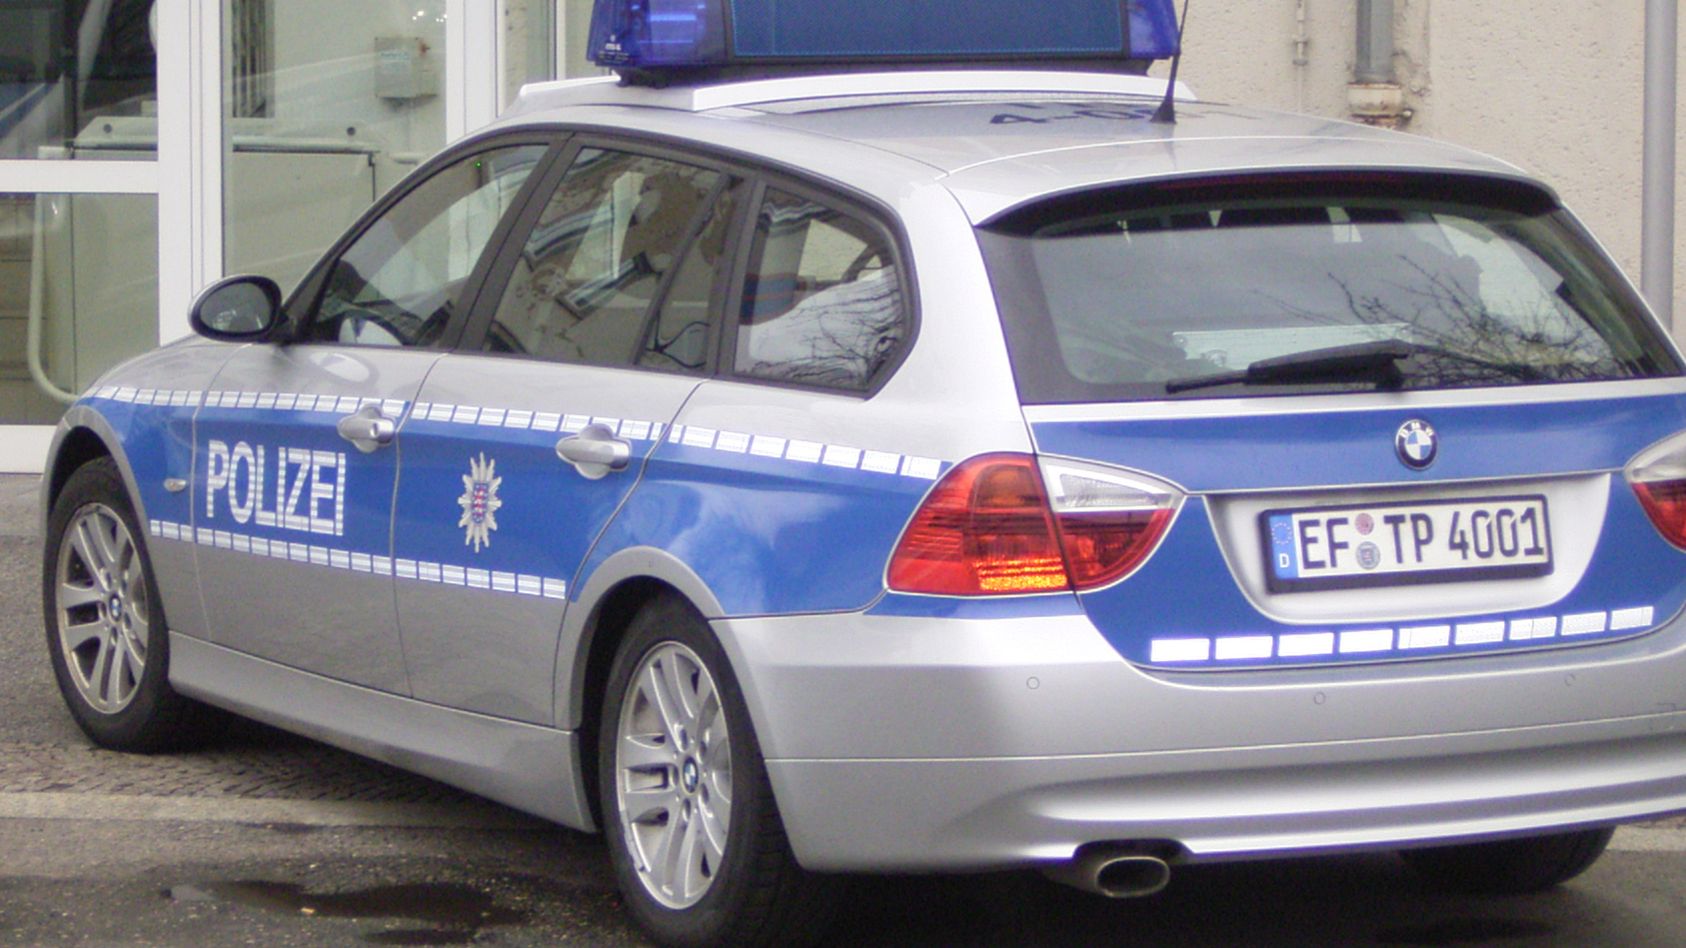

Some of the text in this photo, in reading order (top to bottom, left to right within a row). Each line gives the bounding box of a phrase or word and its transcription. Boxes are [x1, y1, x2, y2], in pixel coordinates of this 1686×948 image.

[206, 440, 346, 536] POLIZEI
[1278, 552, 1291, 568] D
[1298, 507, 1545, 570] EF TP 4001
